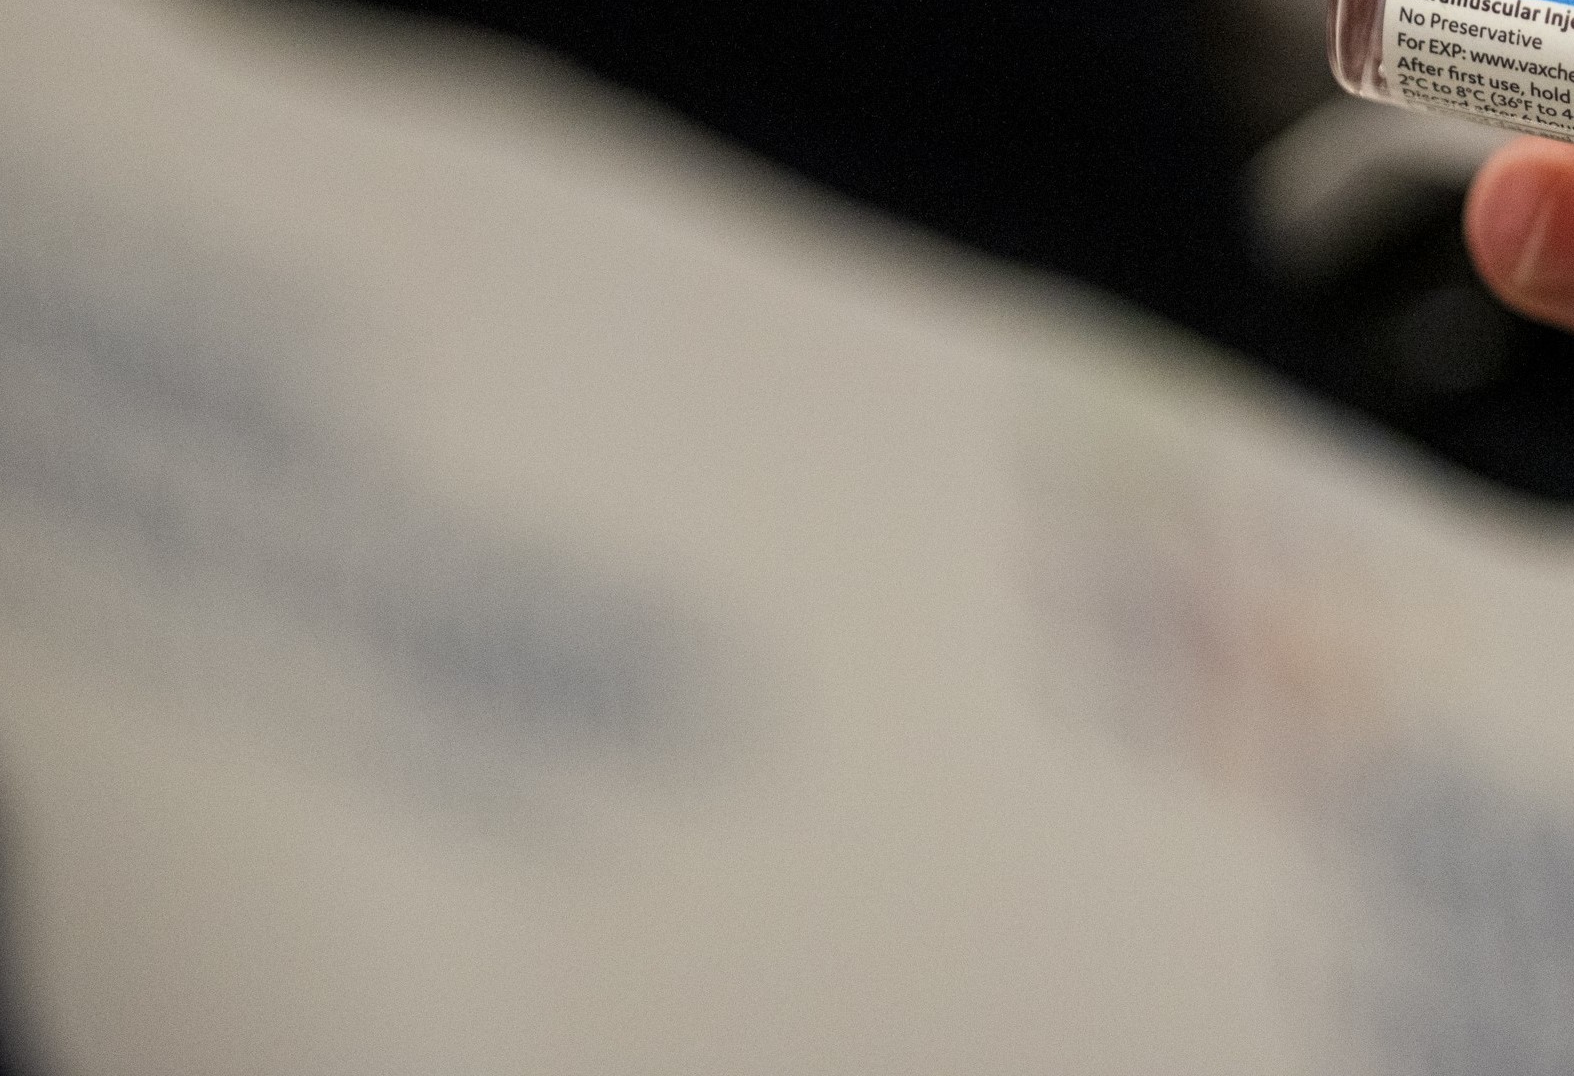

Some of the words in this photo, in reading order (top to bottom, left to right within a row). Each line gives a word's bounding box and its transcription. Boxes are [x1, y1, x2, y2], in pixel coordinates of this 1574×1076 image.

[1397, 32, 1425, 51] For
[1429, 39, 1466, 60] EXP:
[1399, 6, 1425, 26] No
[1431, 13, 1542, 50] Preservative
[1397, 56, 1444, 77] After
[1448, 65, 1485, 87] first
[1489, 77, 1525, 96] use,
[1530, 82, 1571, 104] hold
[1399, 74, 1428, 90] 2°C
[1432, 81, 1452, 95] to
[1456, 85, 1486, 102] 8°C
[1491, 91, 1533, 111] (36°F
[1537, 103, 1557, 117] to
